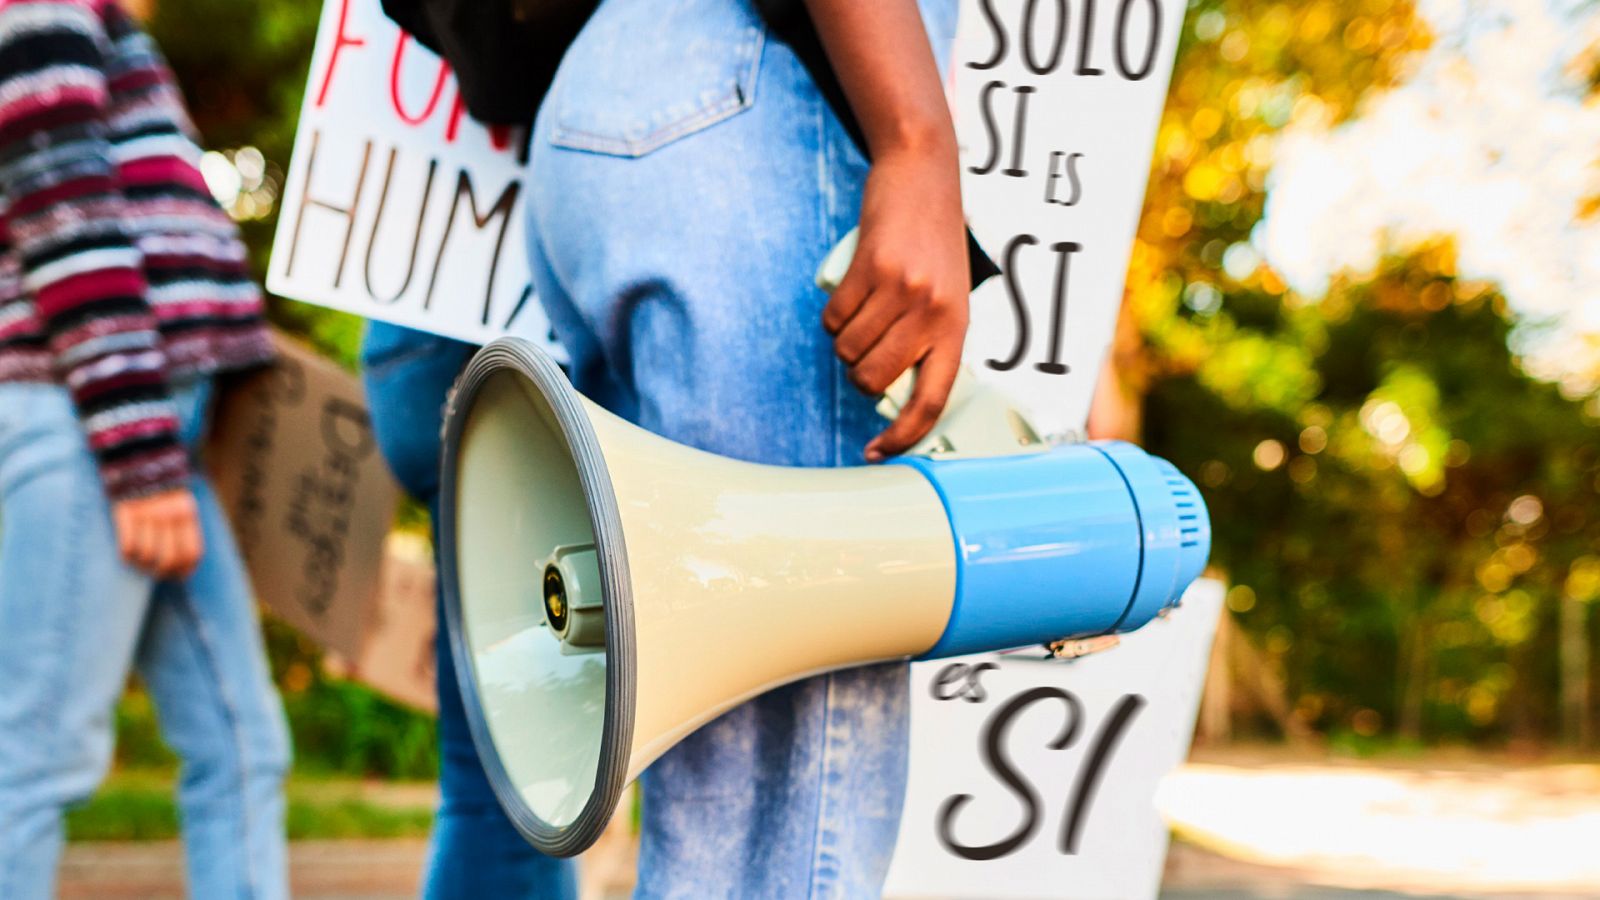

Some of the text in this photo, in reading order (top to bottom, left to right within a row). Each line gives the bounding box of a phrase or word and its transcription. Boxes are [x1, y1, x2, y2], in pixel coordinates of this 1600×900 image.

[966, 0, 1162, 80] SOLO
[969, 81, 1035, 177] SI
[1046, 151, 1083, 206] ES
[983, 234, 1081, 375] SI
[936, 687, 1145, 861] SI
